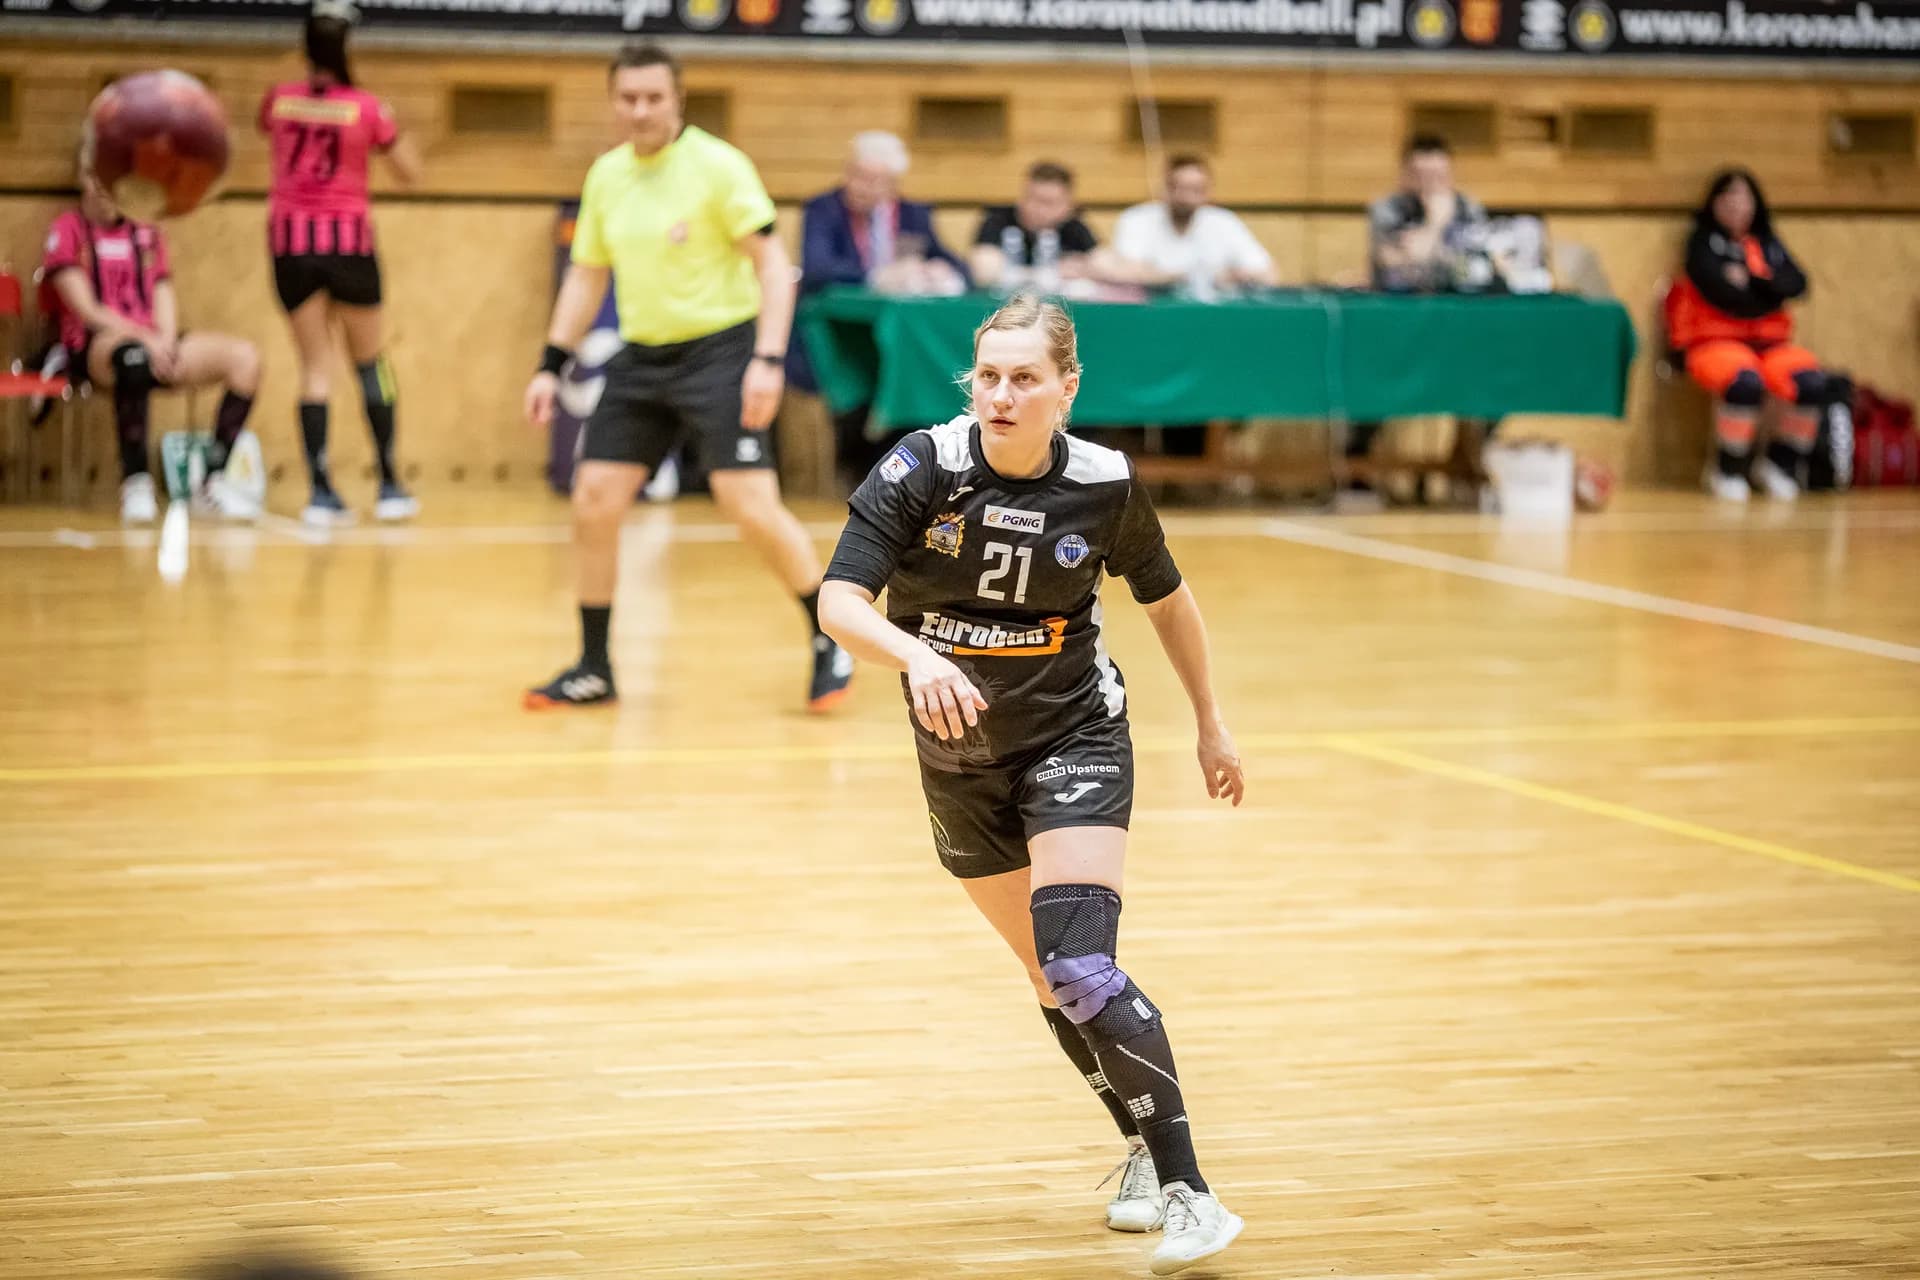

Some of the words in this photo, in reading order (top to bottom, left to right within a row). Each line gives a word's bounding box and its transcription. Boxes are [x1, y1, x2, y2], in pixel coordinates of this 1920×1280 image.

[1002, 514, 1041, 528] PGNiG
[976, 541, 1033, 604] 21
[1037, 767, 1065, 781] ORLEN
[1067, 764, 1119, 776] Upstream
